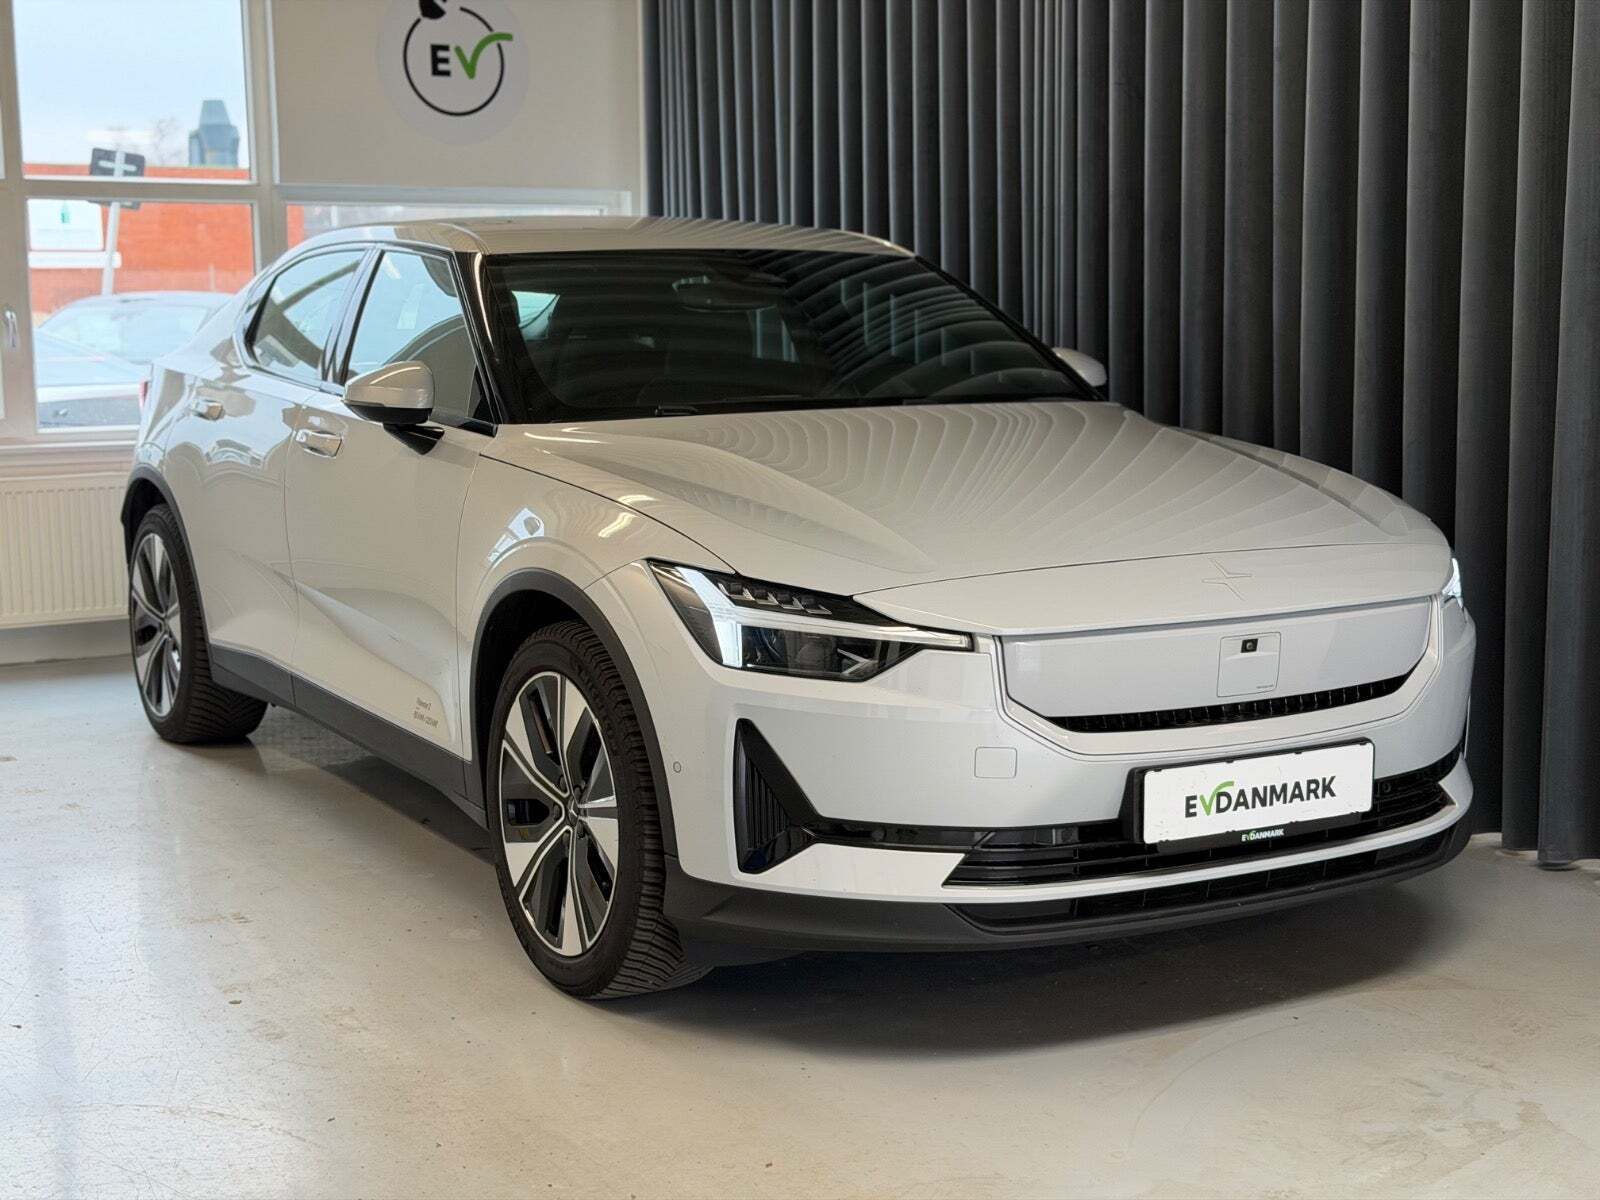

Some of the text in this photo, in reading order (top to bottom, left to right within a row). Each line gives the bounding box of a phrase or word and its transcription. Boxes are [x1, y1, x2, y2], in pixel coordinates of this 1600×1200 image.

[430, 32, 513, 79] EV
[1185, 775, 1336, 818] EVDANMARK
[1241, 829, 1284, 842] EVDANMARK
